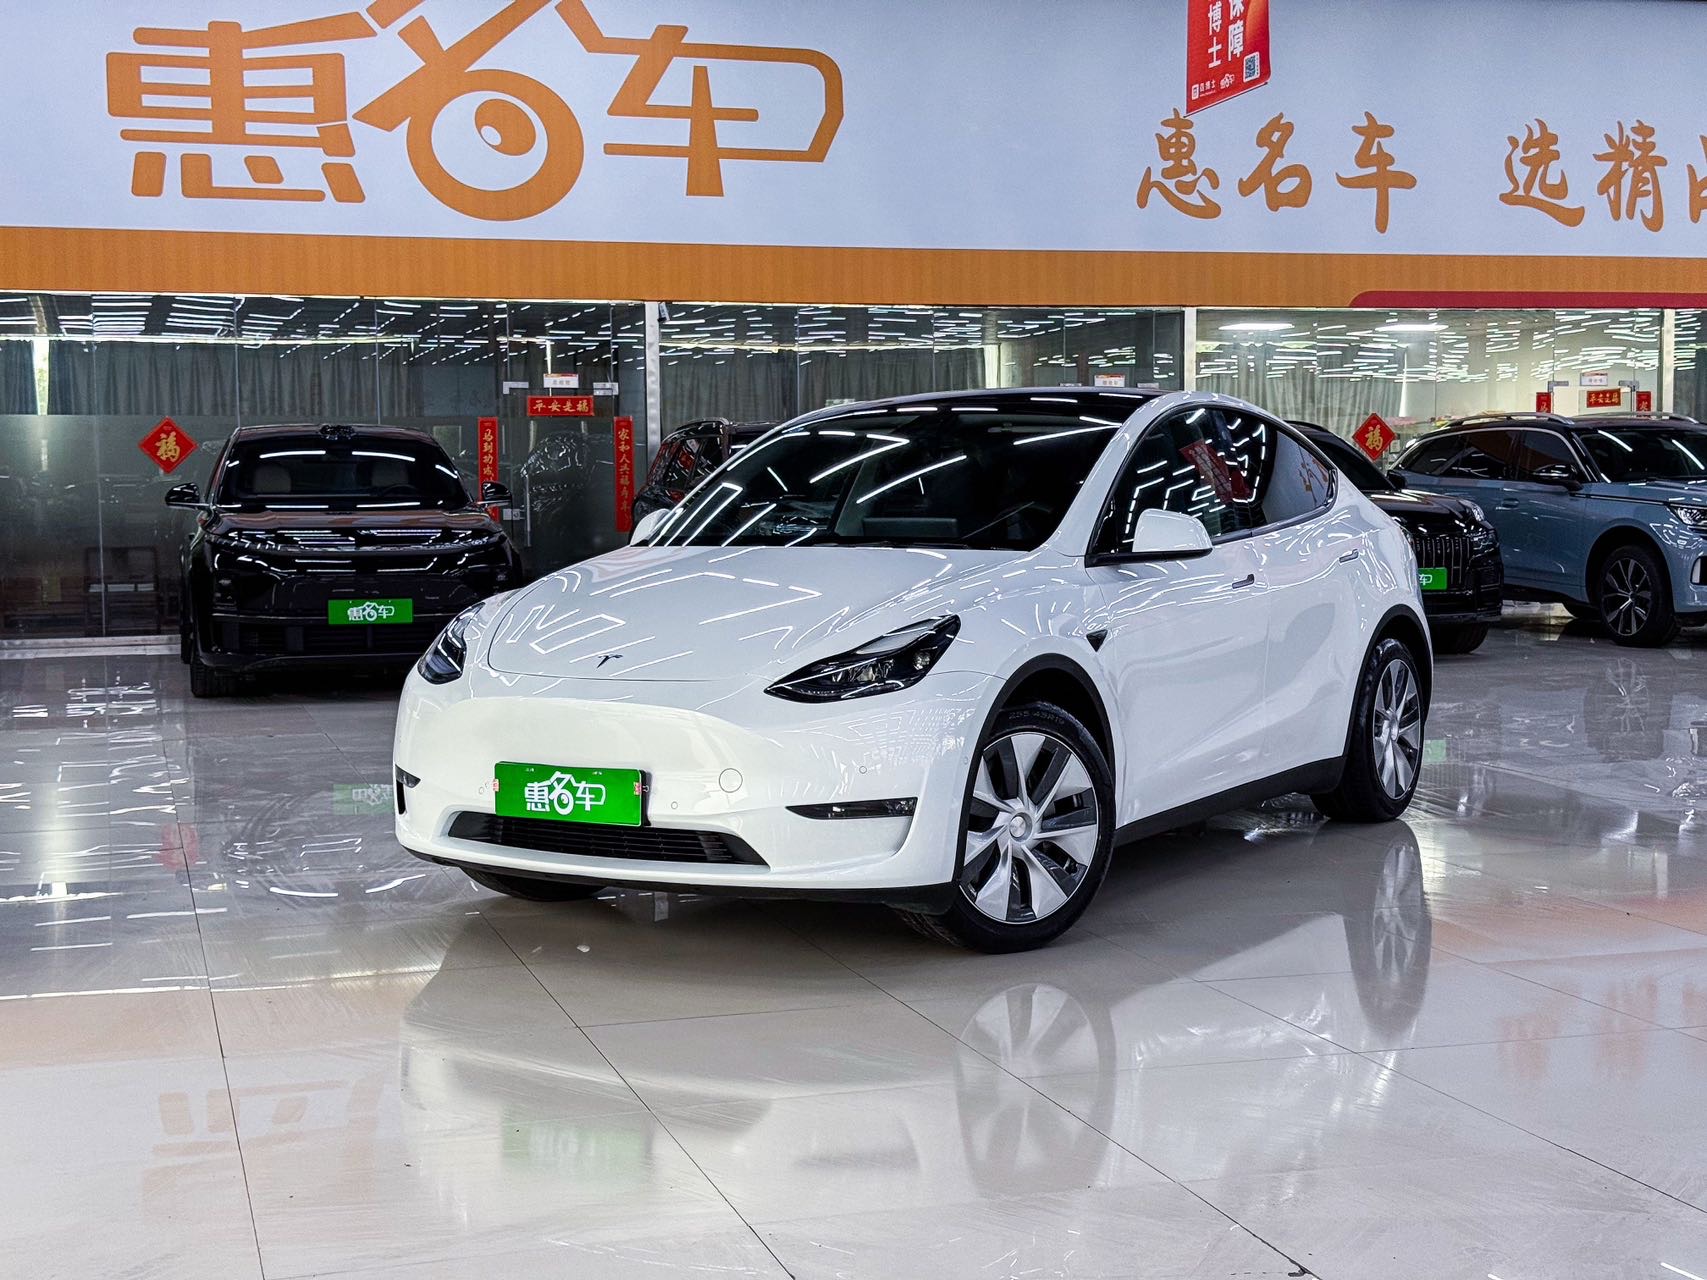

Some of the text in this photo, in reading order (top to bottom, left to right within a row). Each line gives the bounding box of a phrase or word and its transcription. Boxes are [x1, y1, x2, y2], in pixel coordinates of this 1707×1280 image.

[106, 0, 843, 221] 惠名车
[1136, 108, 1417, 234] 惠名车
[155, 430, 181, 462] 福
[1364, 424, 1384, 451] 福
[347, 601, 395, 622] 惠名车
[524, 771, 606, 816] 惠名车
